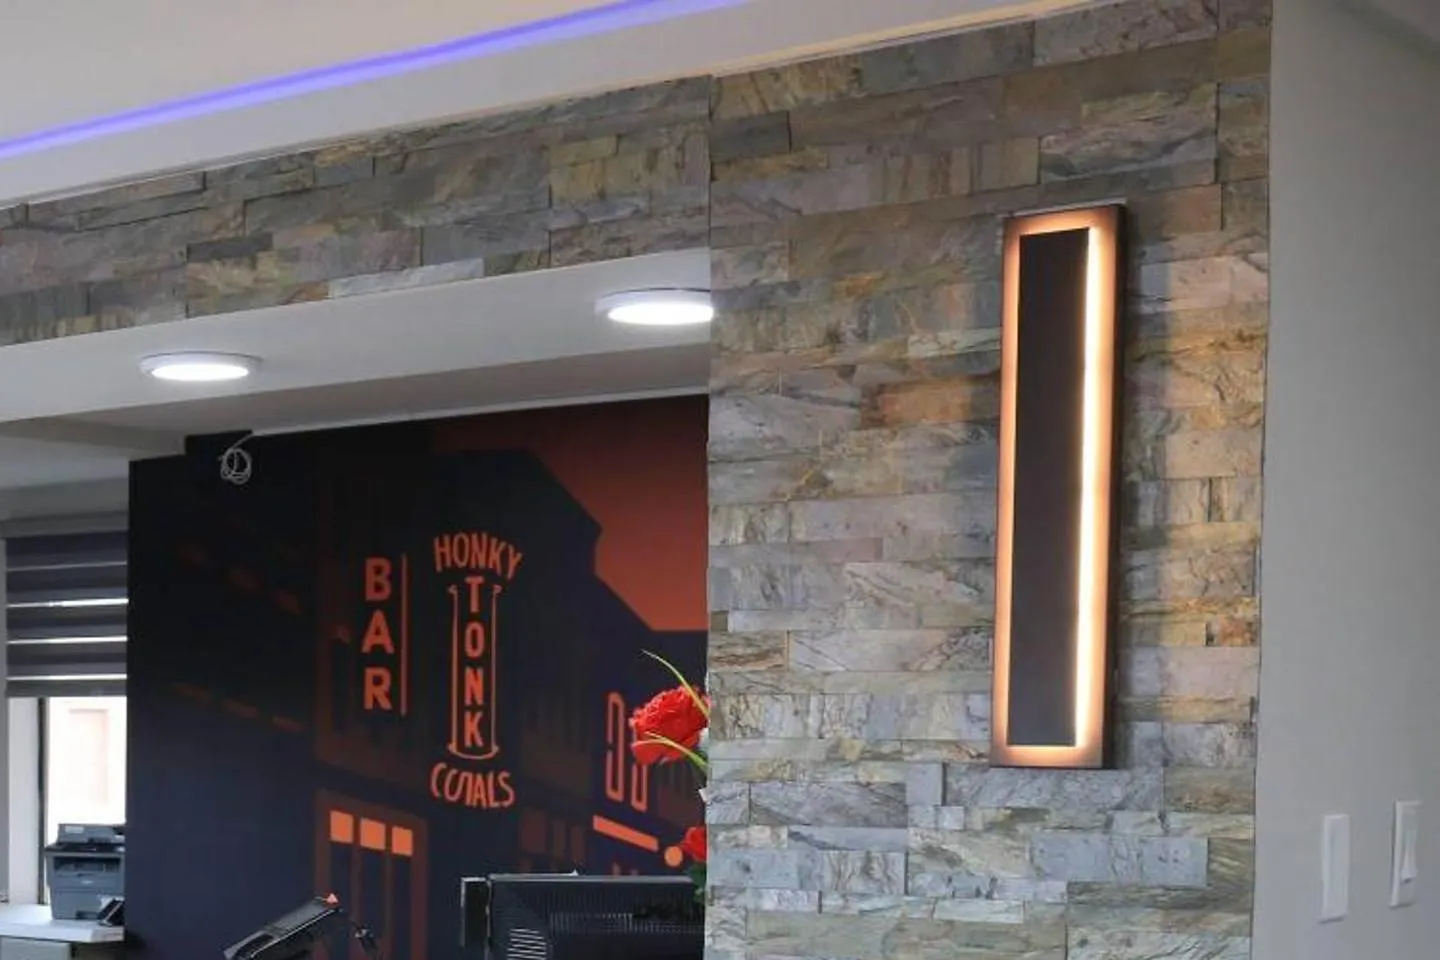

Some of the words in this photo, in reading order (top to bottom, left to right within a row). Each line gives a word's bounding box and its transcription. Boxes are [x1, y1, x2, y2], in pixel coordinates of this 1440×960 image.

[434, 532, 523, 580] HONKY
[362, 557, 394, 711] BAR
[464, 575, 485, 748] TONK
